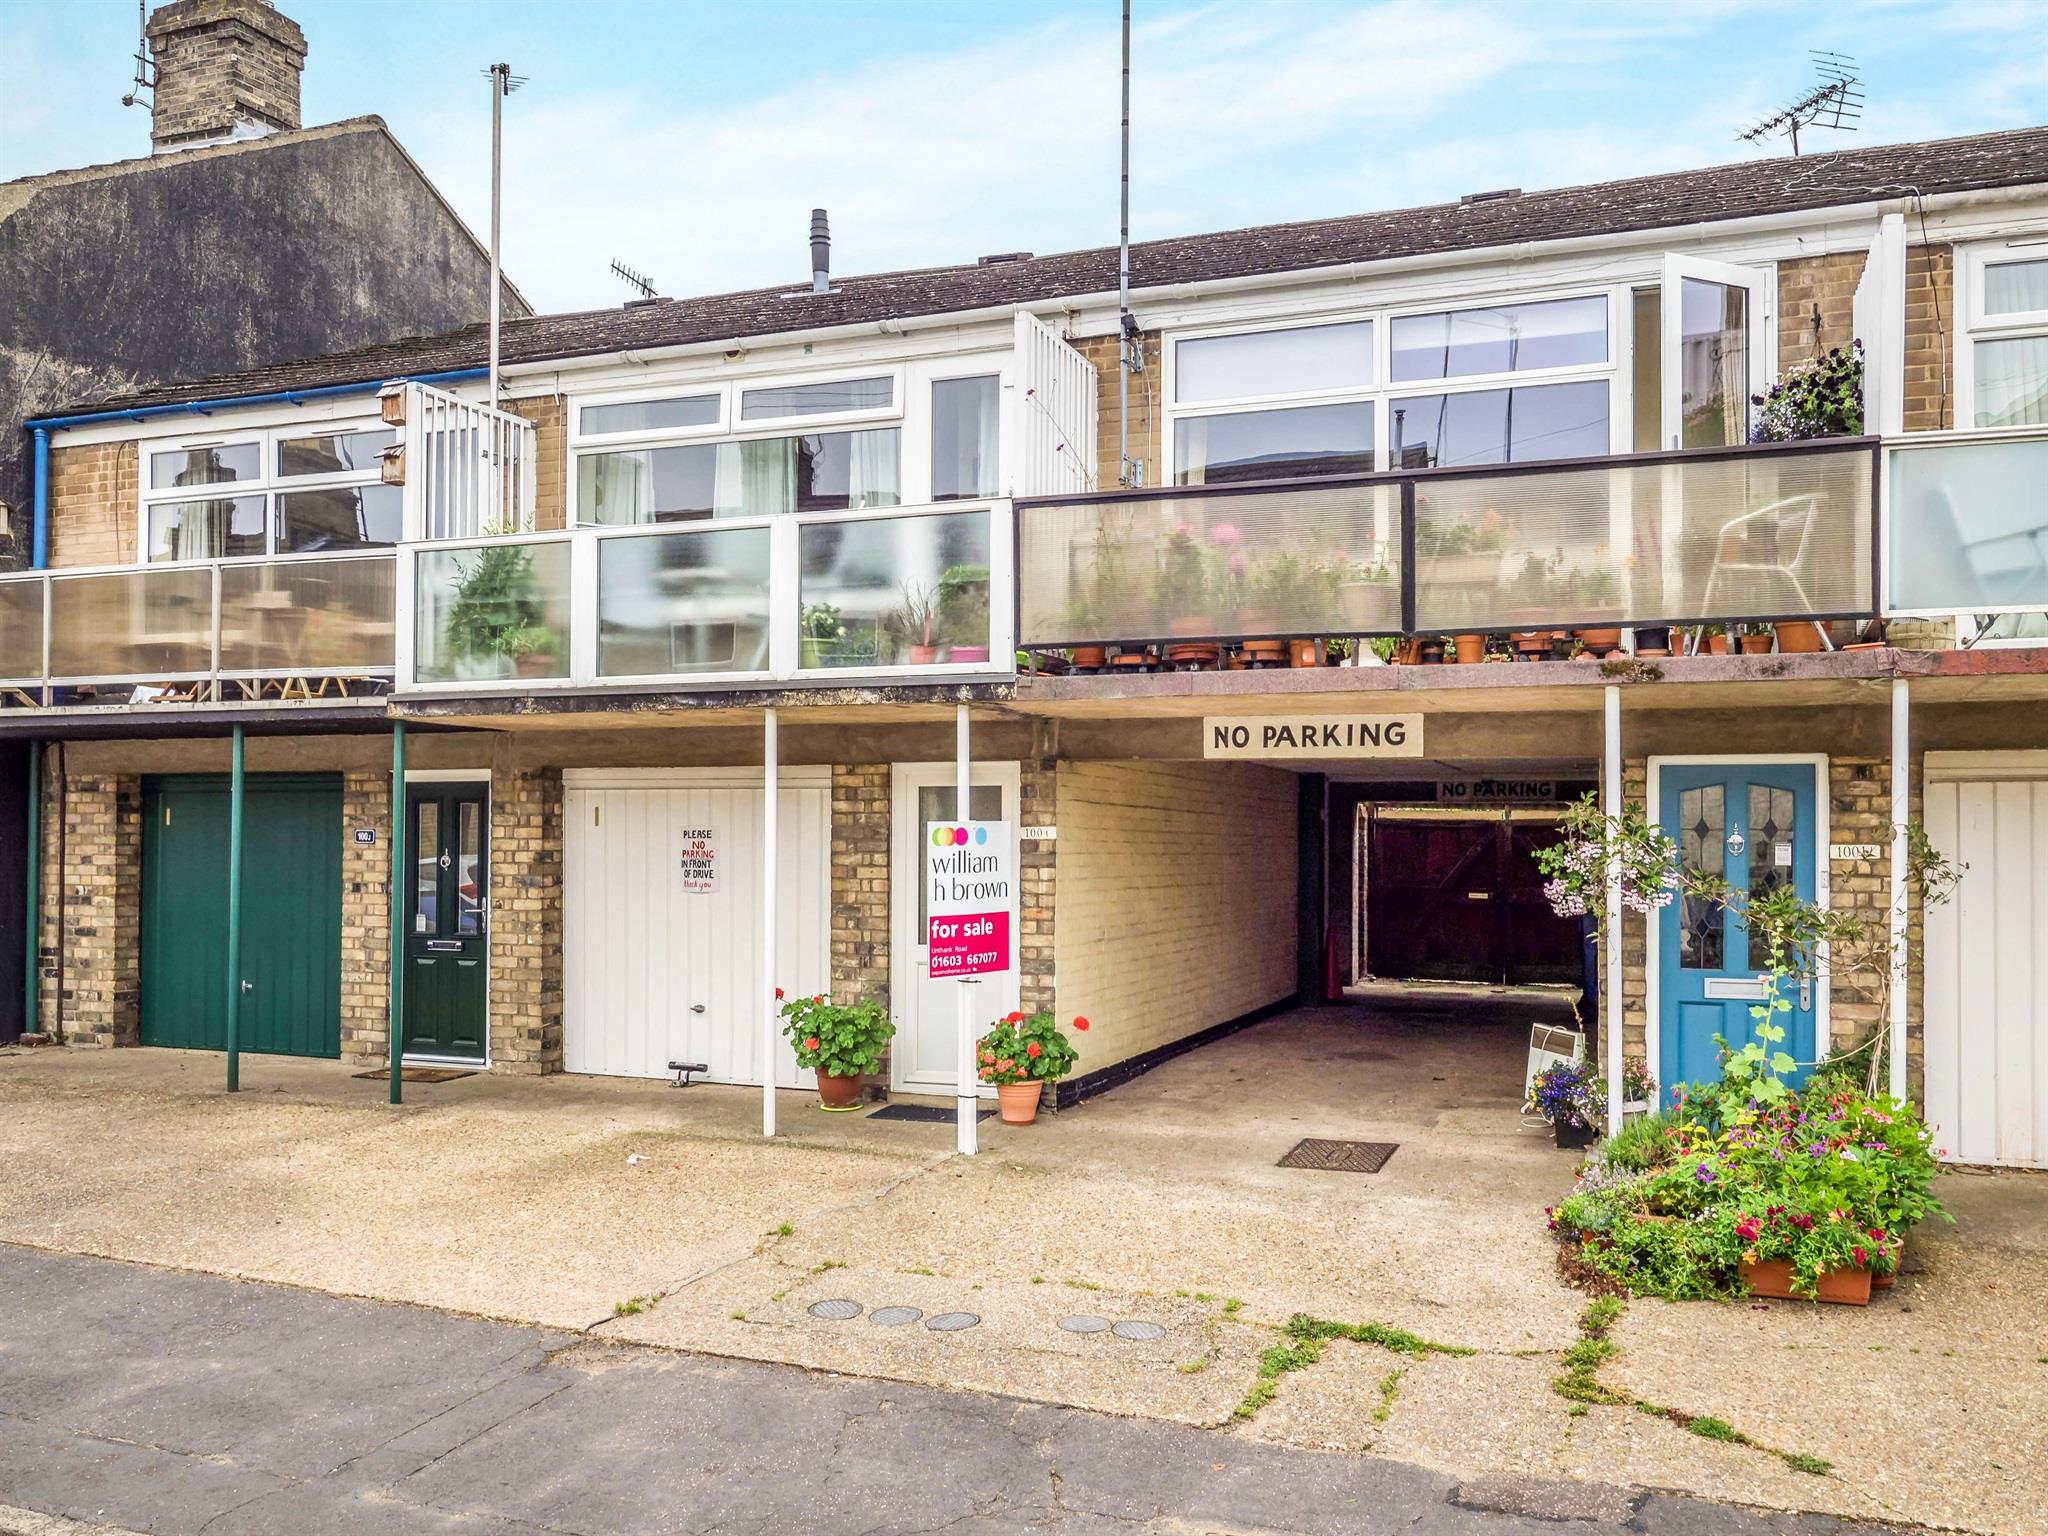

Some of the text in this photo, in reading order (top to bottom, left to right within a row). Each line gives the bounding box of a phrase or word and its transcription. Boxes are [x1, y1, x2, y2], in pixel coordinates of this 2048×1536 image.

[1214, 721, 1406, 749] NO PARKING
[1442, 781, 1552, 797] NO PARKING
[683, 830, 712, 839] PLEASE
[692, 840, 706, 850] NO
[682, 850, 714, 859] PARKING
[681, 860, 712, 869] IN FRONT
[932, 850, 999, 874] william
[684, 869, 714, 879] OF DRIVE
[699, 882, 712, 892] you
[934, 877, 1008, 902] h brown
[931, 917, 993, 939] for sale
[931, 945, 968, 954] Unthank Road
[932, 952, 998, 968] 01603 667077
